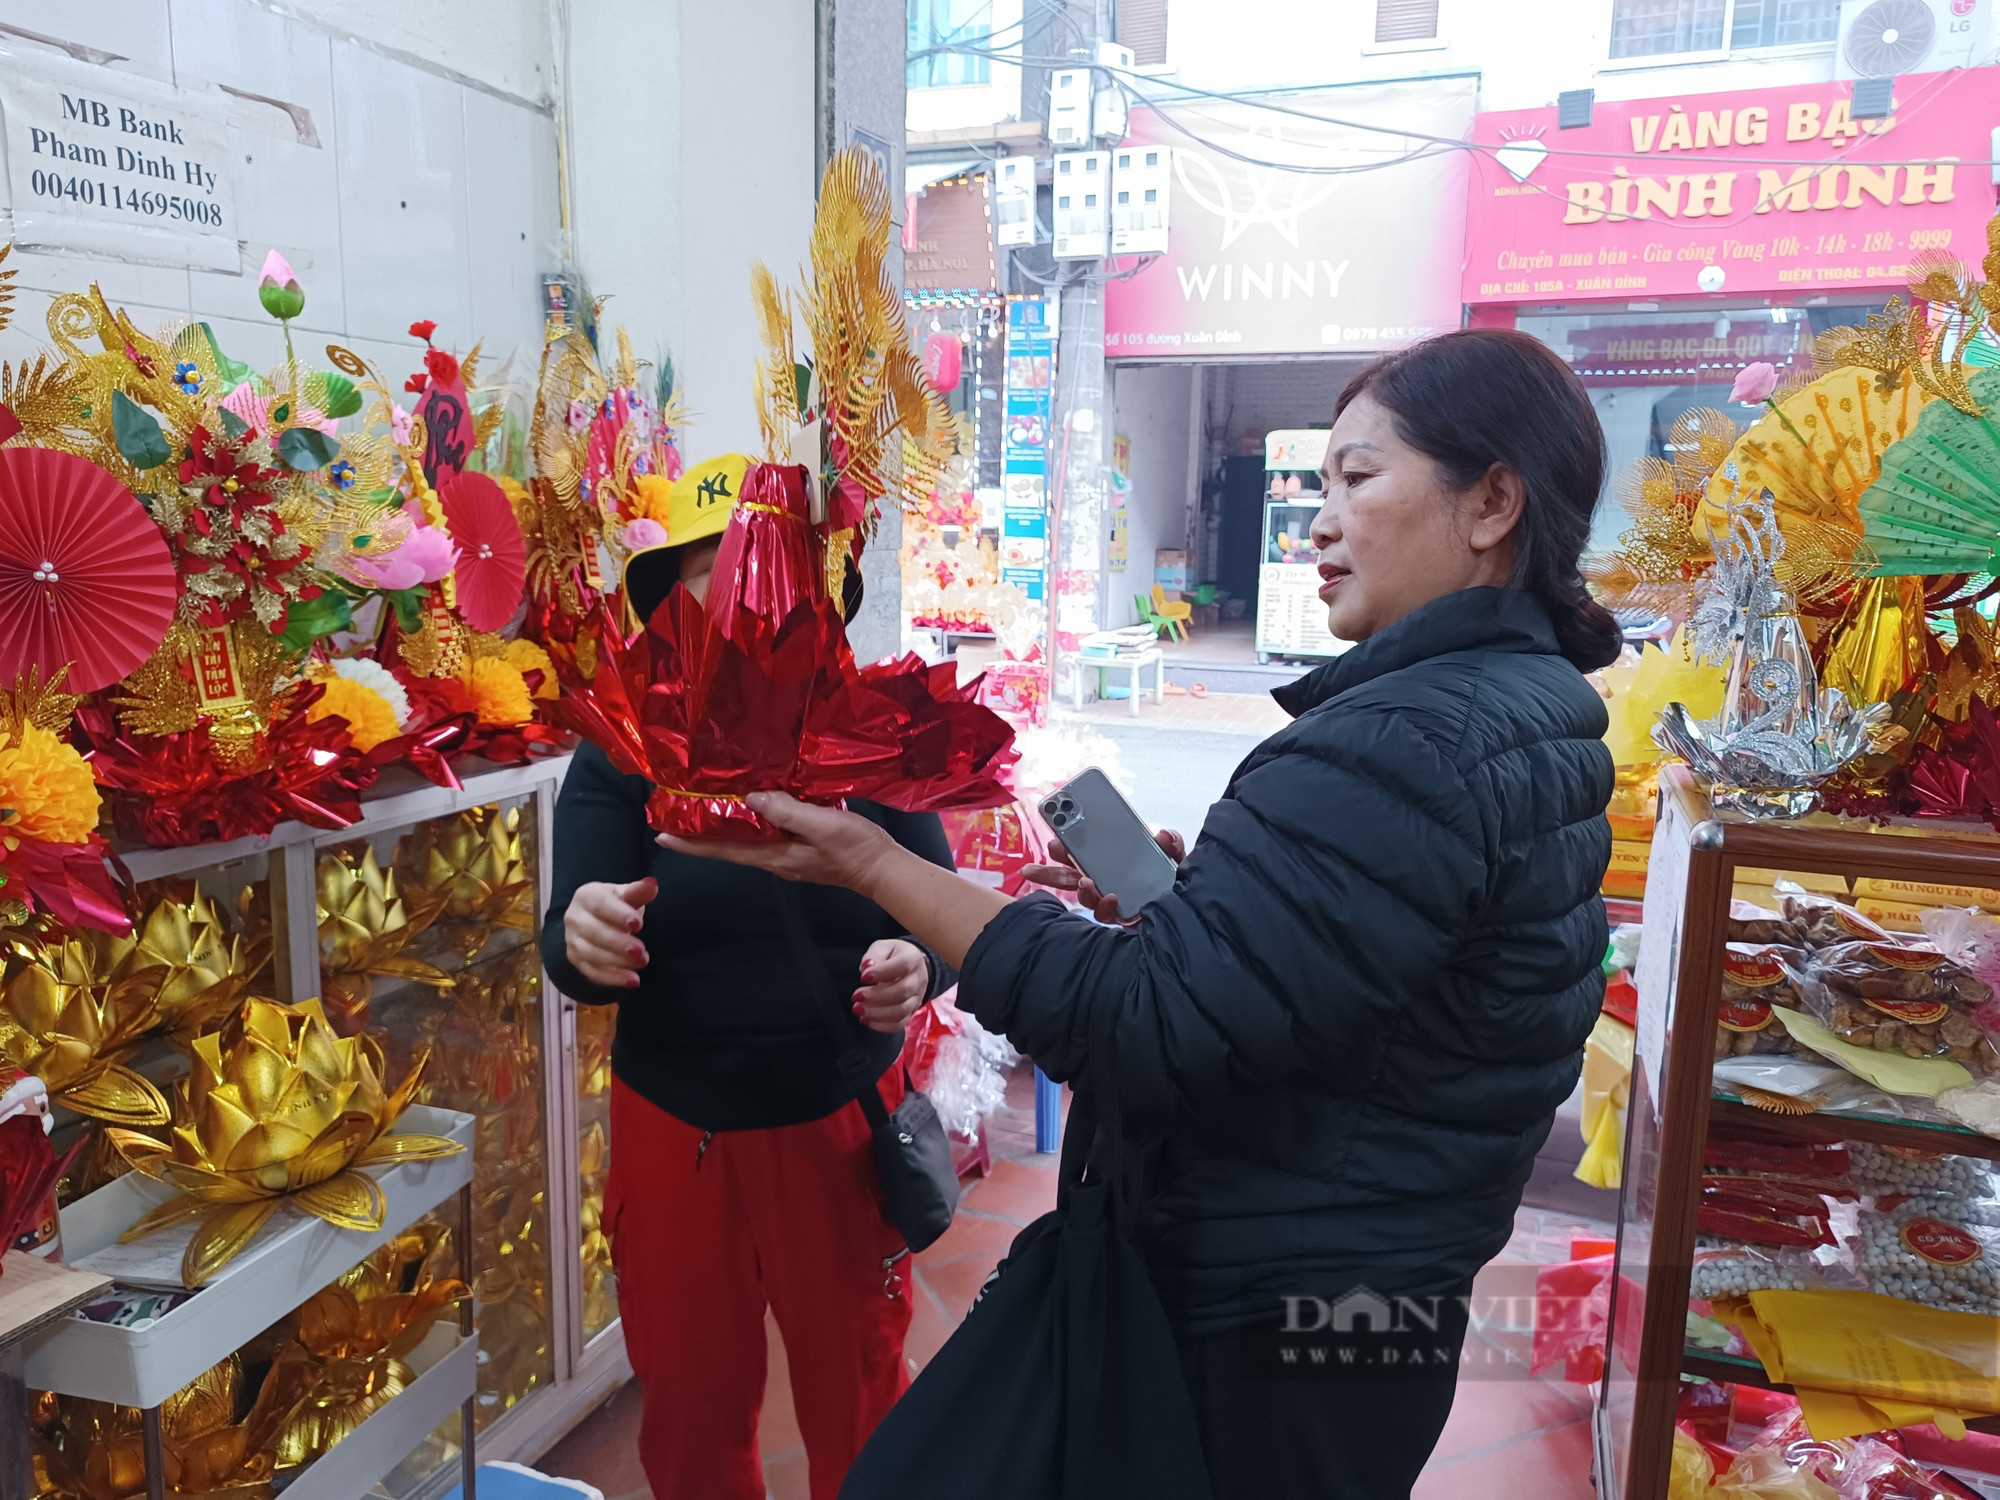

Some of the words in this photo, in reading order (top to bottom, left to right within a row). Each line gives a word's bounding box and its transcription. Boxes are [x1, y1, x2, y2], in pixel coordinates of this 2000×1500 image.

[1950, 20, 1971, 33] LG
[59, 93, 110, 127] MB
[118, 107, 185, 145] Bank
[1630, 104, 1769, 153] VÀNG
[29, 127, 108, 168] Pham
[115, 146, 176, 181] Dinh
[183, 161, 217, 195] Hy
[31, 169, 223, 227] 0040114695008
[1563, 166, 1738, 225] BÌNH
[1754, 155, 1960, 215] MINH
[1497, 250, 1554, 273] Chuyên
[1559, 252, 1593, 267] mua
[1598, 246, 1628, 265] bán
[1643, 243, 1672, 264] Gia
[1677, 242, 1717, 265] công
[1722, 238, 1766, 263] Vàng
[1770, 236, 1799, 258] 10k
[1815, 233, 1846, 256] 14k
[1861, 231, 1893, 253] 18k
[1908, 229, 1953, 251] 9999
[1176, 259, 1350, 302] WINNY
[1534, 279, 1565, 293] 105A
[1576, 276, 1612, 291] XUÂN
[1778, 266, 1812, 283] ĐIỆN
[1105, 331, 1121, 347] Số
[1122, 333, 1144, 347] 105
[1146, 332, 1181, 348] đường
[1183, 330, 1213, 344] Xuân
[1607, 336, 1657, 361] VÀNG
[1660, 336, 1698, 363] BẠC
[697, 472, 733, 508] NY
[205, 665, 226, 681] TẤN
[208, 681, 229, 698] LỘC
[1915, 882, 1974, 898] NGUYÊN
